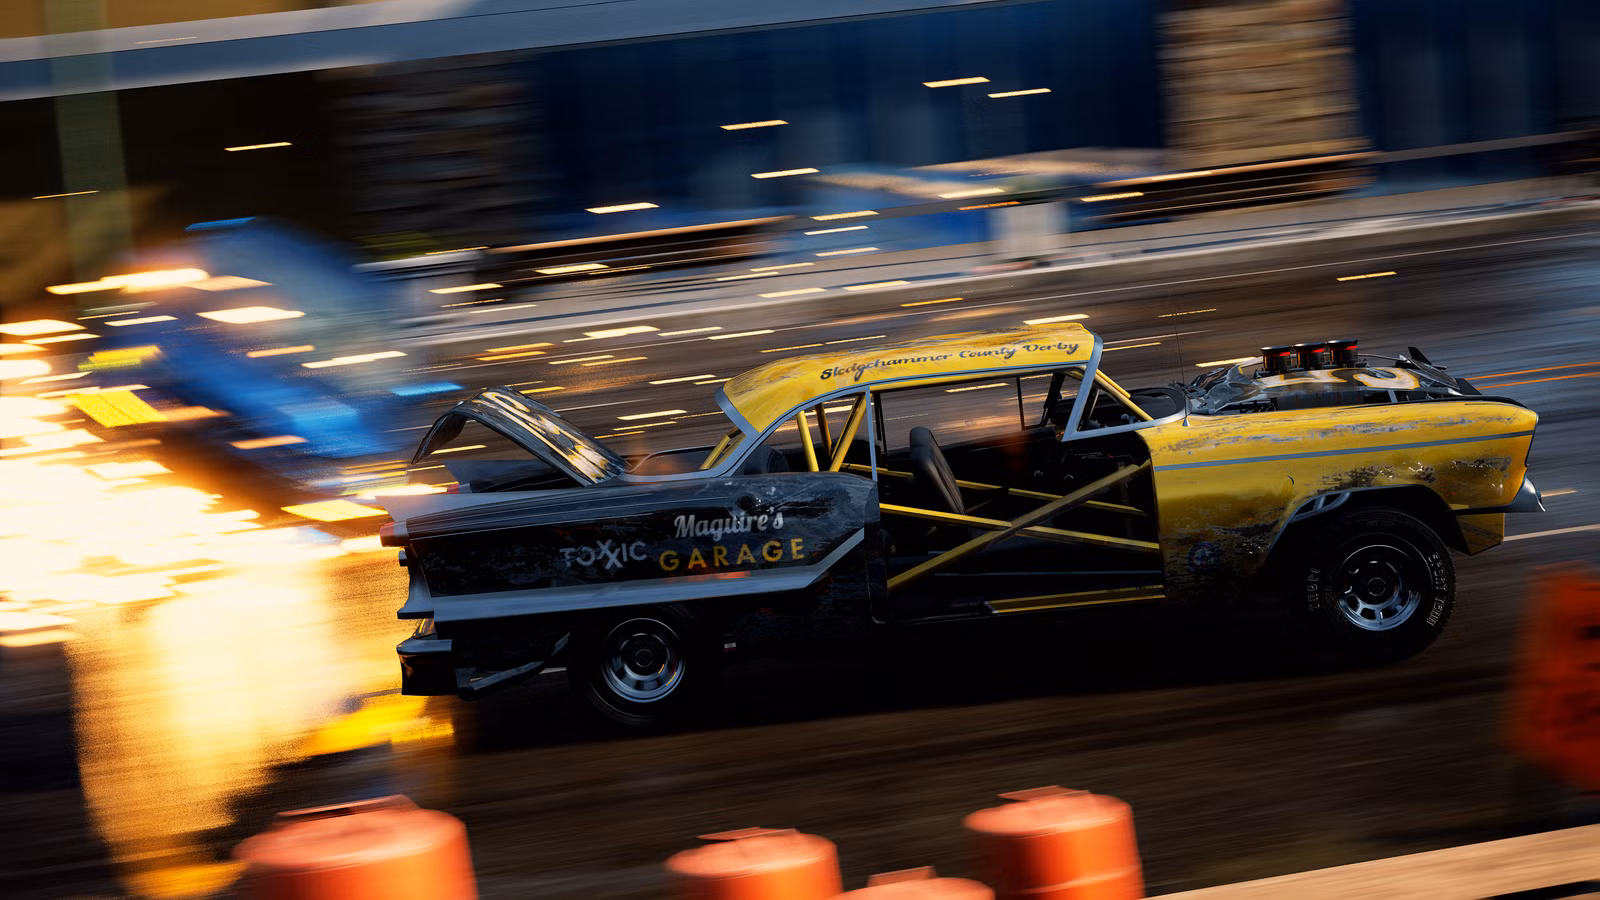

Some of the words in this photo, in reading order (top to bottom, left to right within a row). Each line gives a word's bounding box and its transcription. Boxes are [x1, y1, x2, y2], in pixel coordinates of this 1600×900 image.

[819, 354, 953, 382] Sledgehammer
[959, 347, 1017, 360] County
[1022, 342, 1079, 355] Derby
[674, 506, 784, 542] Maguire's
[559, 539, 648, 570] TOXXIC
[659, 538, 805, 571] GARAGE
